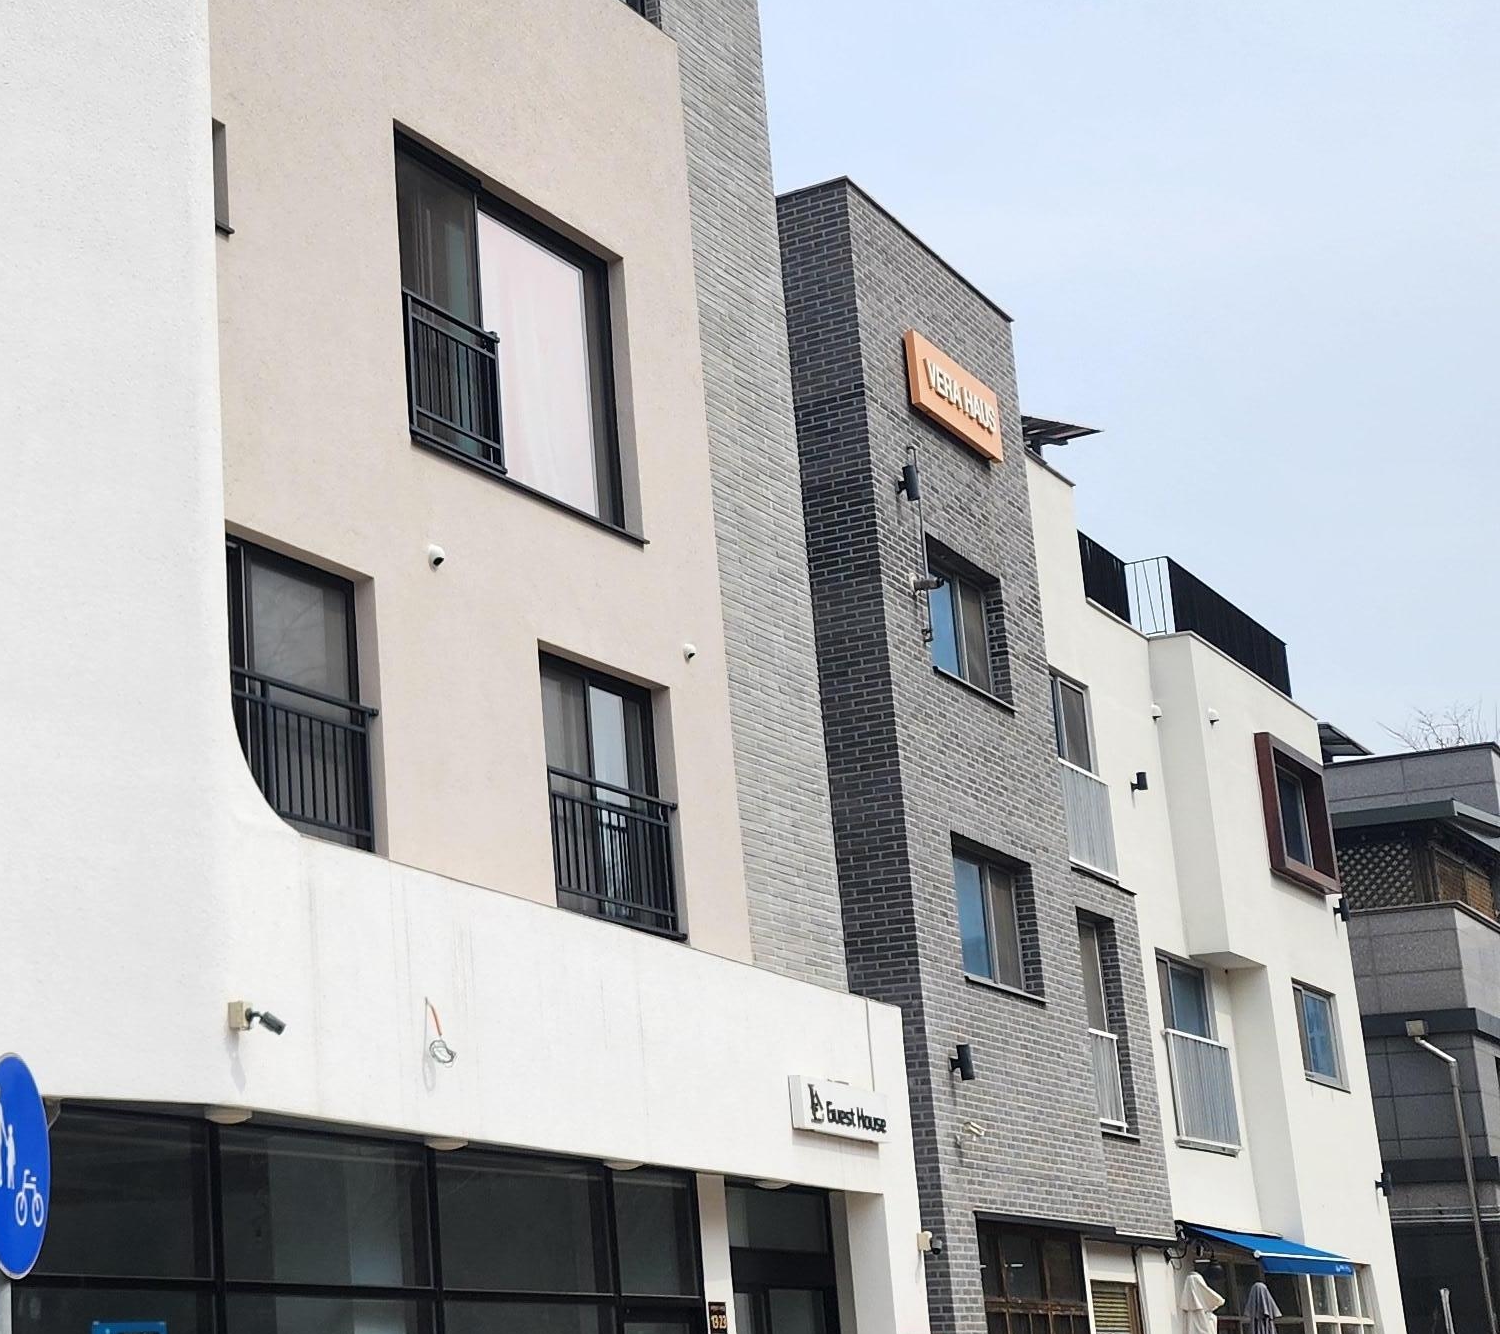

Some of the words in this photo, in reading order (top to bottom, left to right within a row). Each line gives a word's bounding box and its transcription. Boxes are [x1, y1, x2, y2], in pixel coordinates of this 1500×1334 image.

[923, 357, 962, 411] VERA
[960, 386, 997, 435] HAUS
[826, 1100, 857, 1129] Guest
[857, 1107, 888, 1134] House
